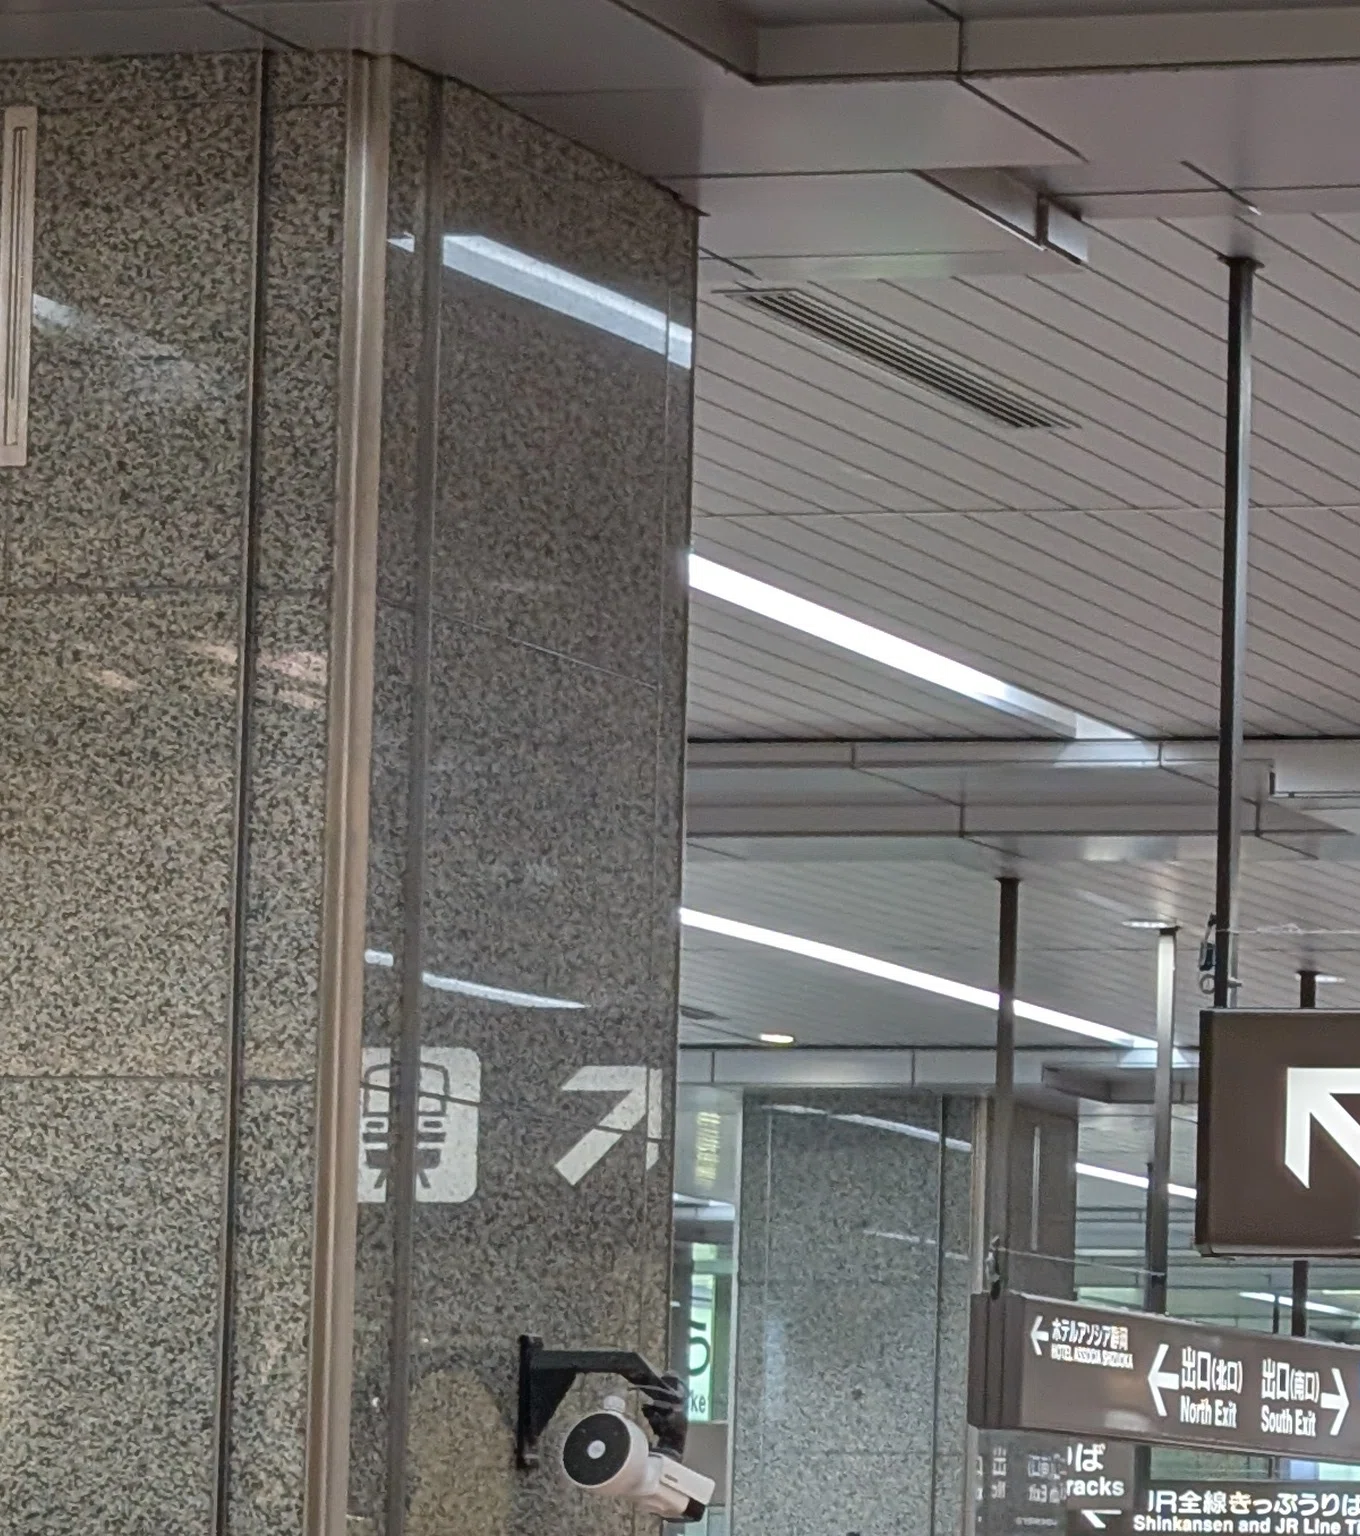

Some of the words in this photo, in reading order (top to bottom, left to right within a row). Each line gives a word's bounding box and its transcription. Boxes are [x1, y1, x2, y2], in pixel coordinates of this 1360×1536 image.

[1180, 1395, 1212, 1425] North
[1214, 1400, 1238, 1429] Exit
[1261, 1404, 1293, 1435] South
[1295, 1408, 1317, 1437] Exit
[1134, 1515, 1233, 1532] Shinkansen
[1239, 1517, 1270, 1533] and
[1275, 1518, 1298, 1534] JR
[1304, 1518, 1341, 1535] Line
